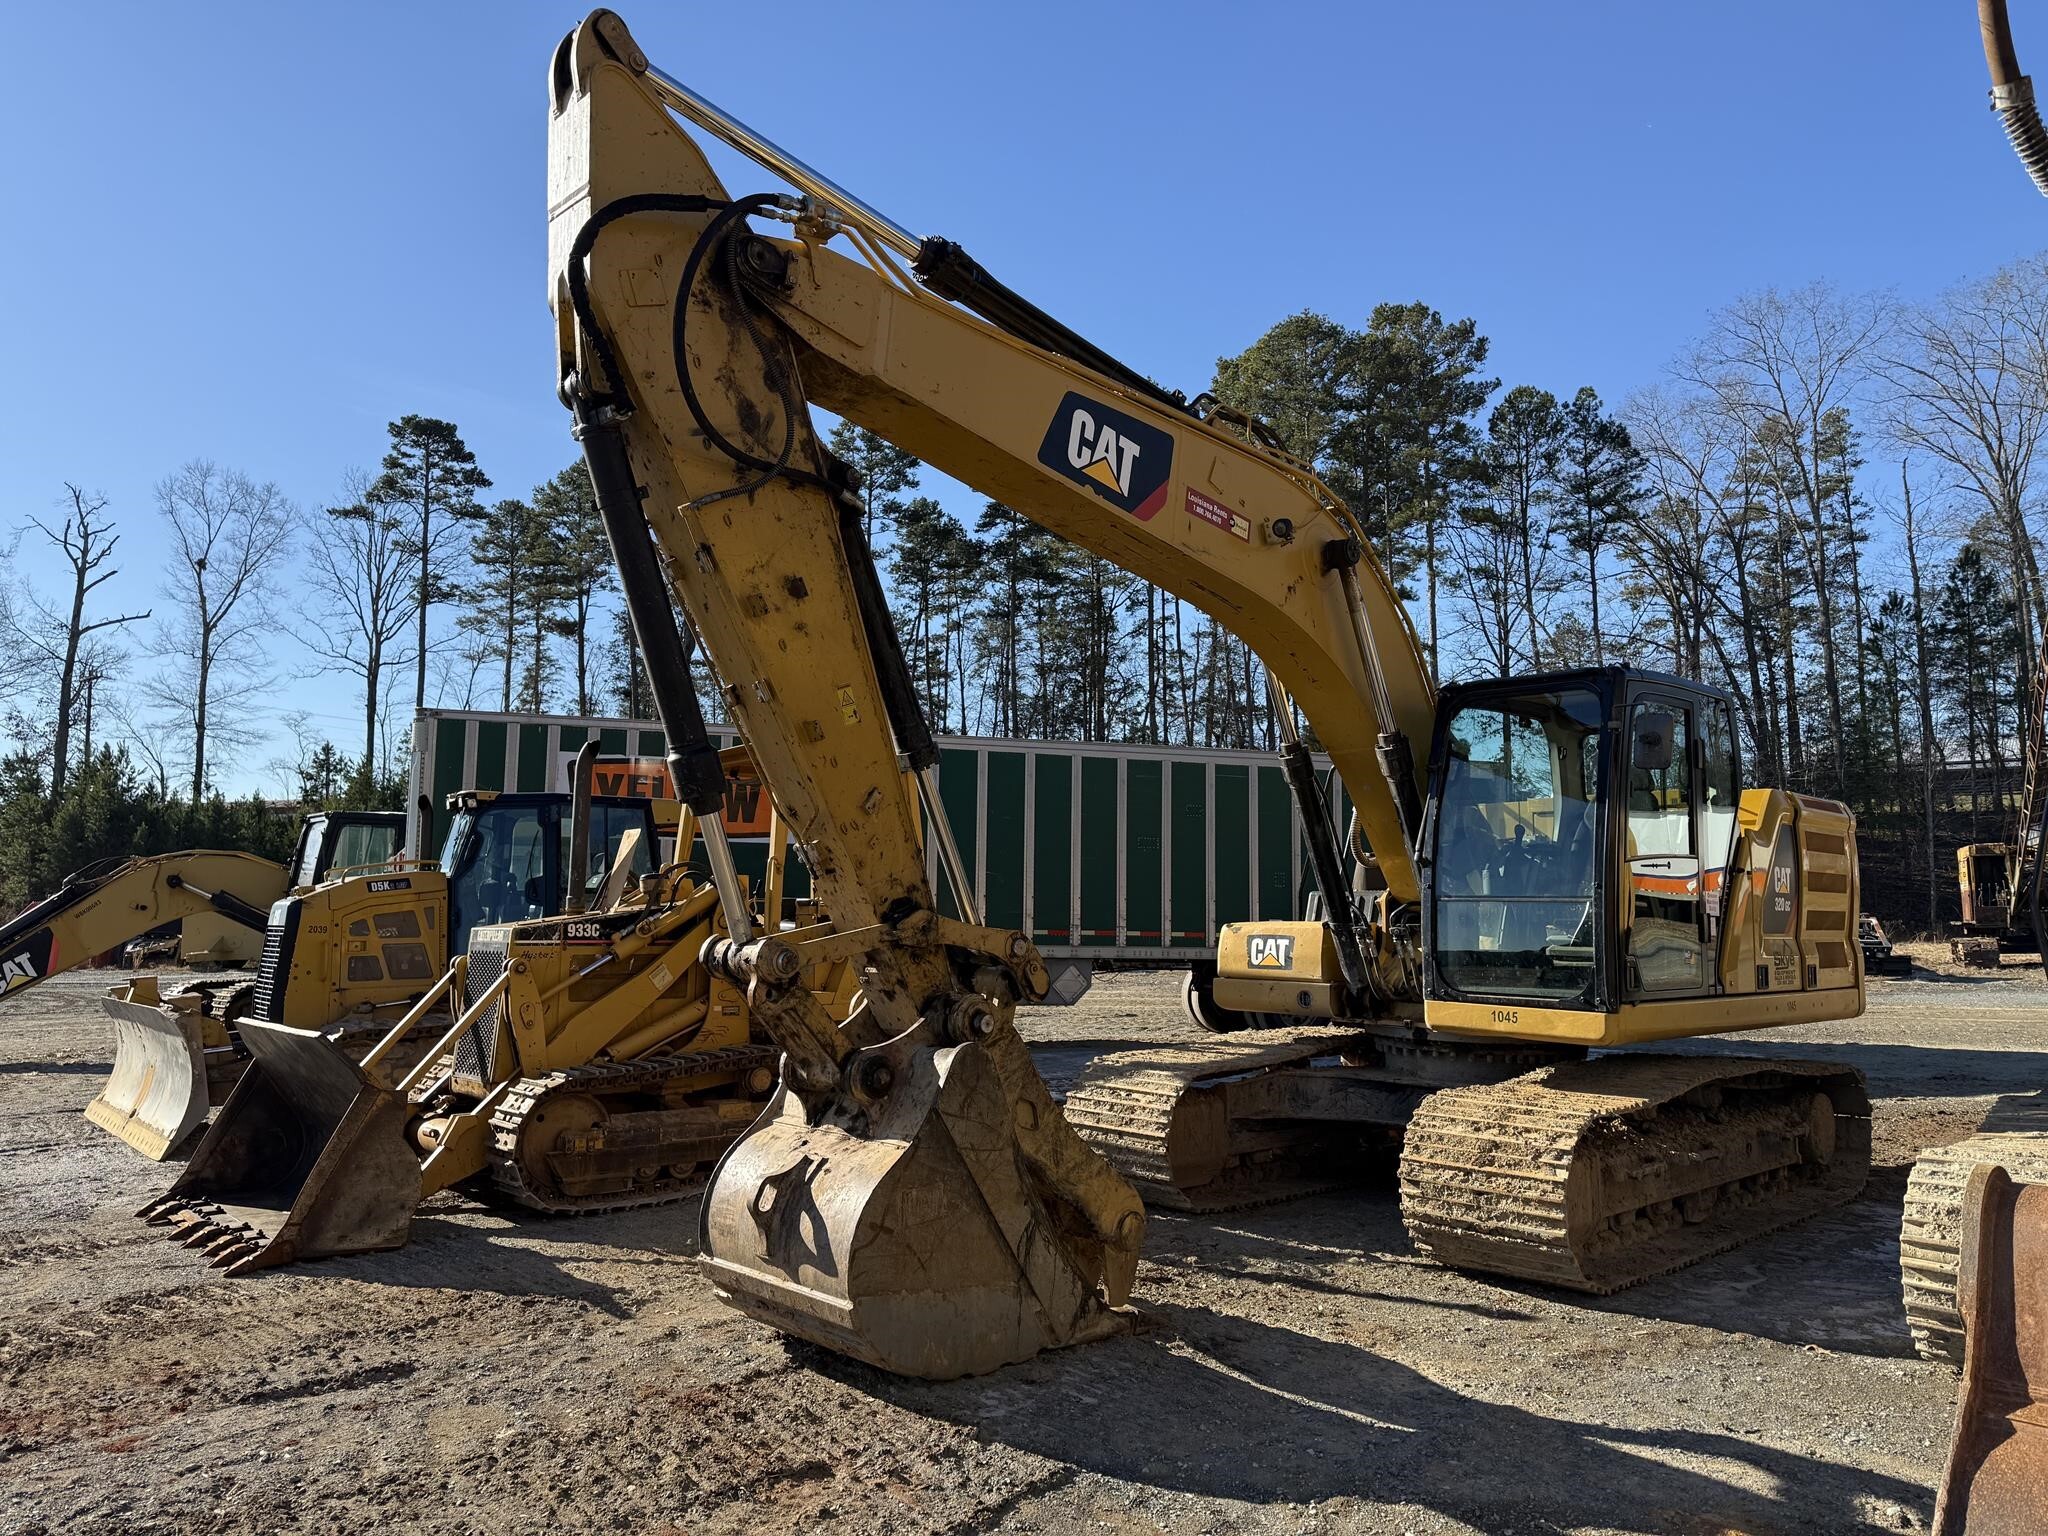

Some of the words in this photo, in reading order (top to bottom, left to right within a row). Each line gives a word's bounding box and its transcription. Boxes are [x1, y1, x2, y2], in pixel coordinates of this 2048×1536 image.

[1068, 409, 1140, 497] CAT
[1774, 866, 1791, 893] CAT
[1774, 897, 1785, 911] 320
[308, 925, 328, 934] 2039
[567, 923, 600, 937] 933C
[1250, 938, 1290, 966] CAT
[1490, 1010, 1518, 1024] 1045
